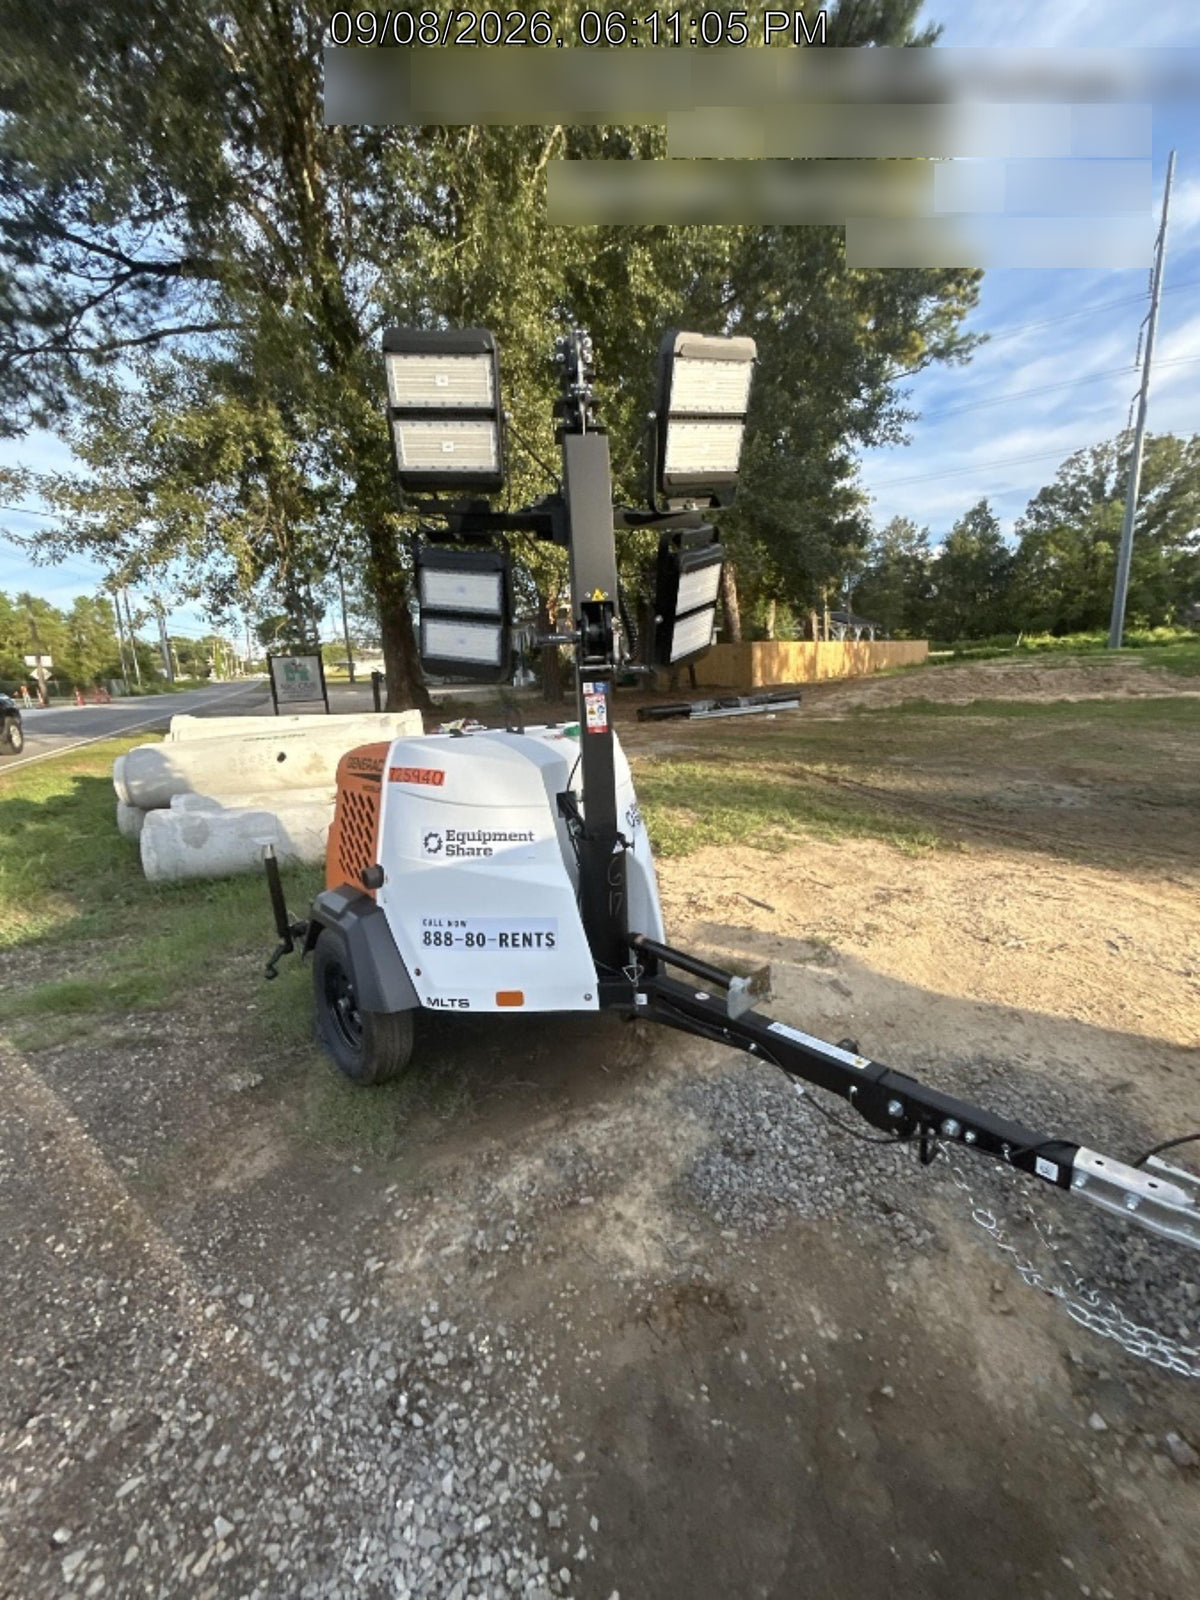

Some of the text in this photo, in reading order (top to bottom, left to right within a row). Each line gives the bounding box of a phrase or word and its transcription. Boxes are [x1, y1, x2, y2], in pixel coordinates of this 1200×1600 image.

[446, 829, 535, 845] Equipment
[446, 844, 493, 857] Share
[422, 918, 467, 928] CALL NOW
[423, 931, 556, 949] 888-80-RENTS
